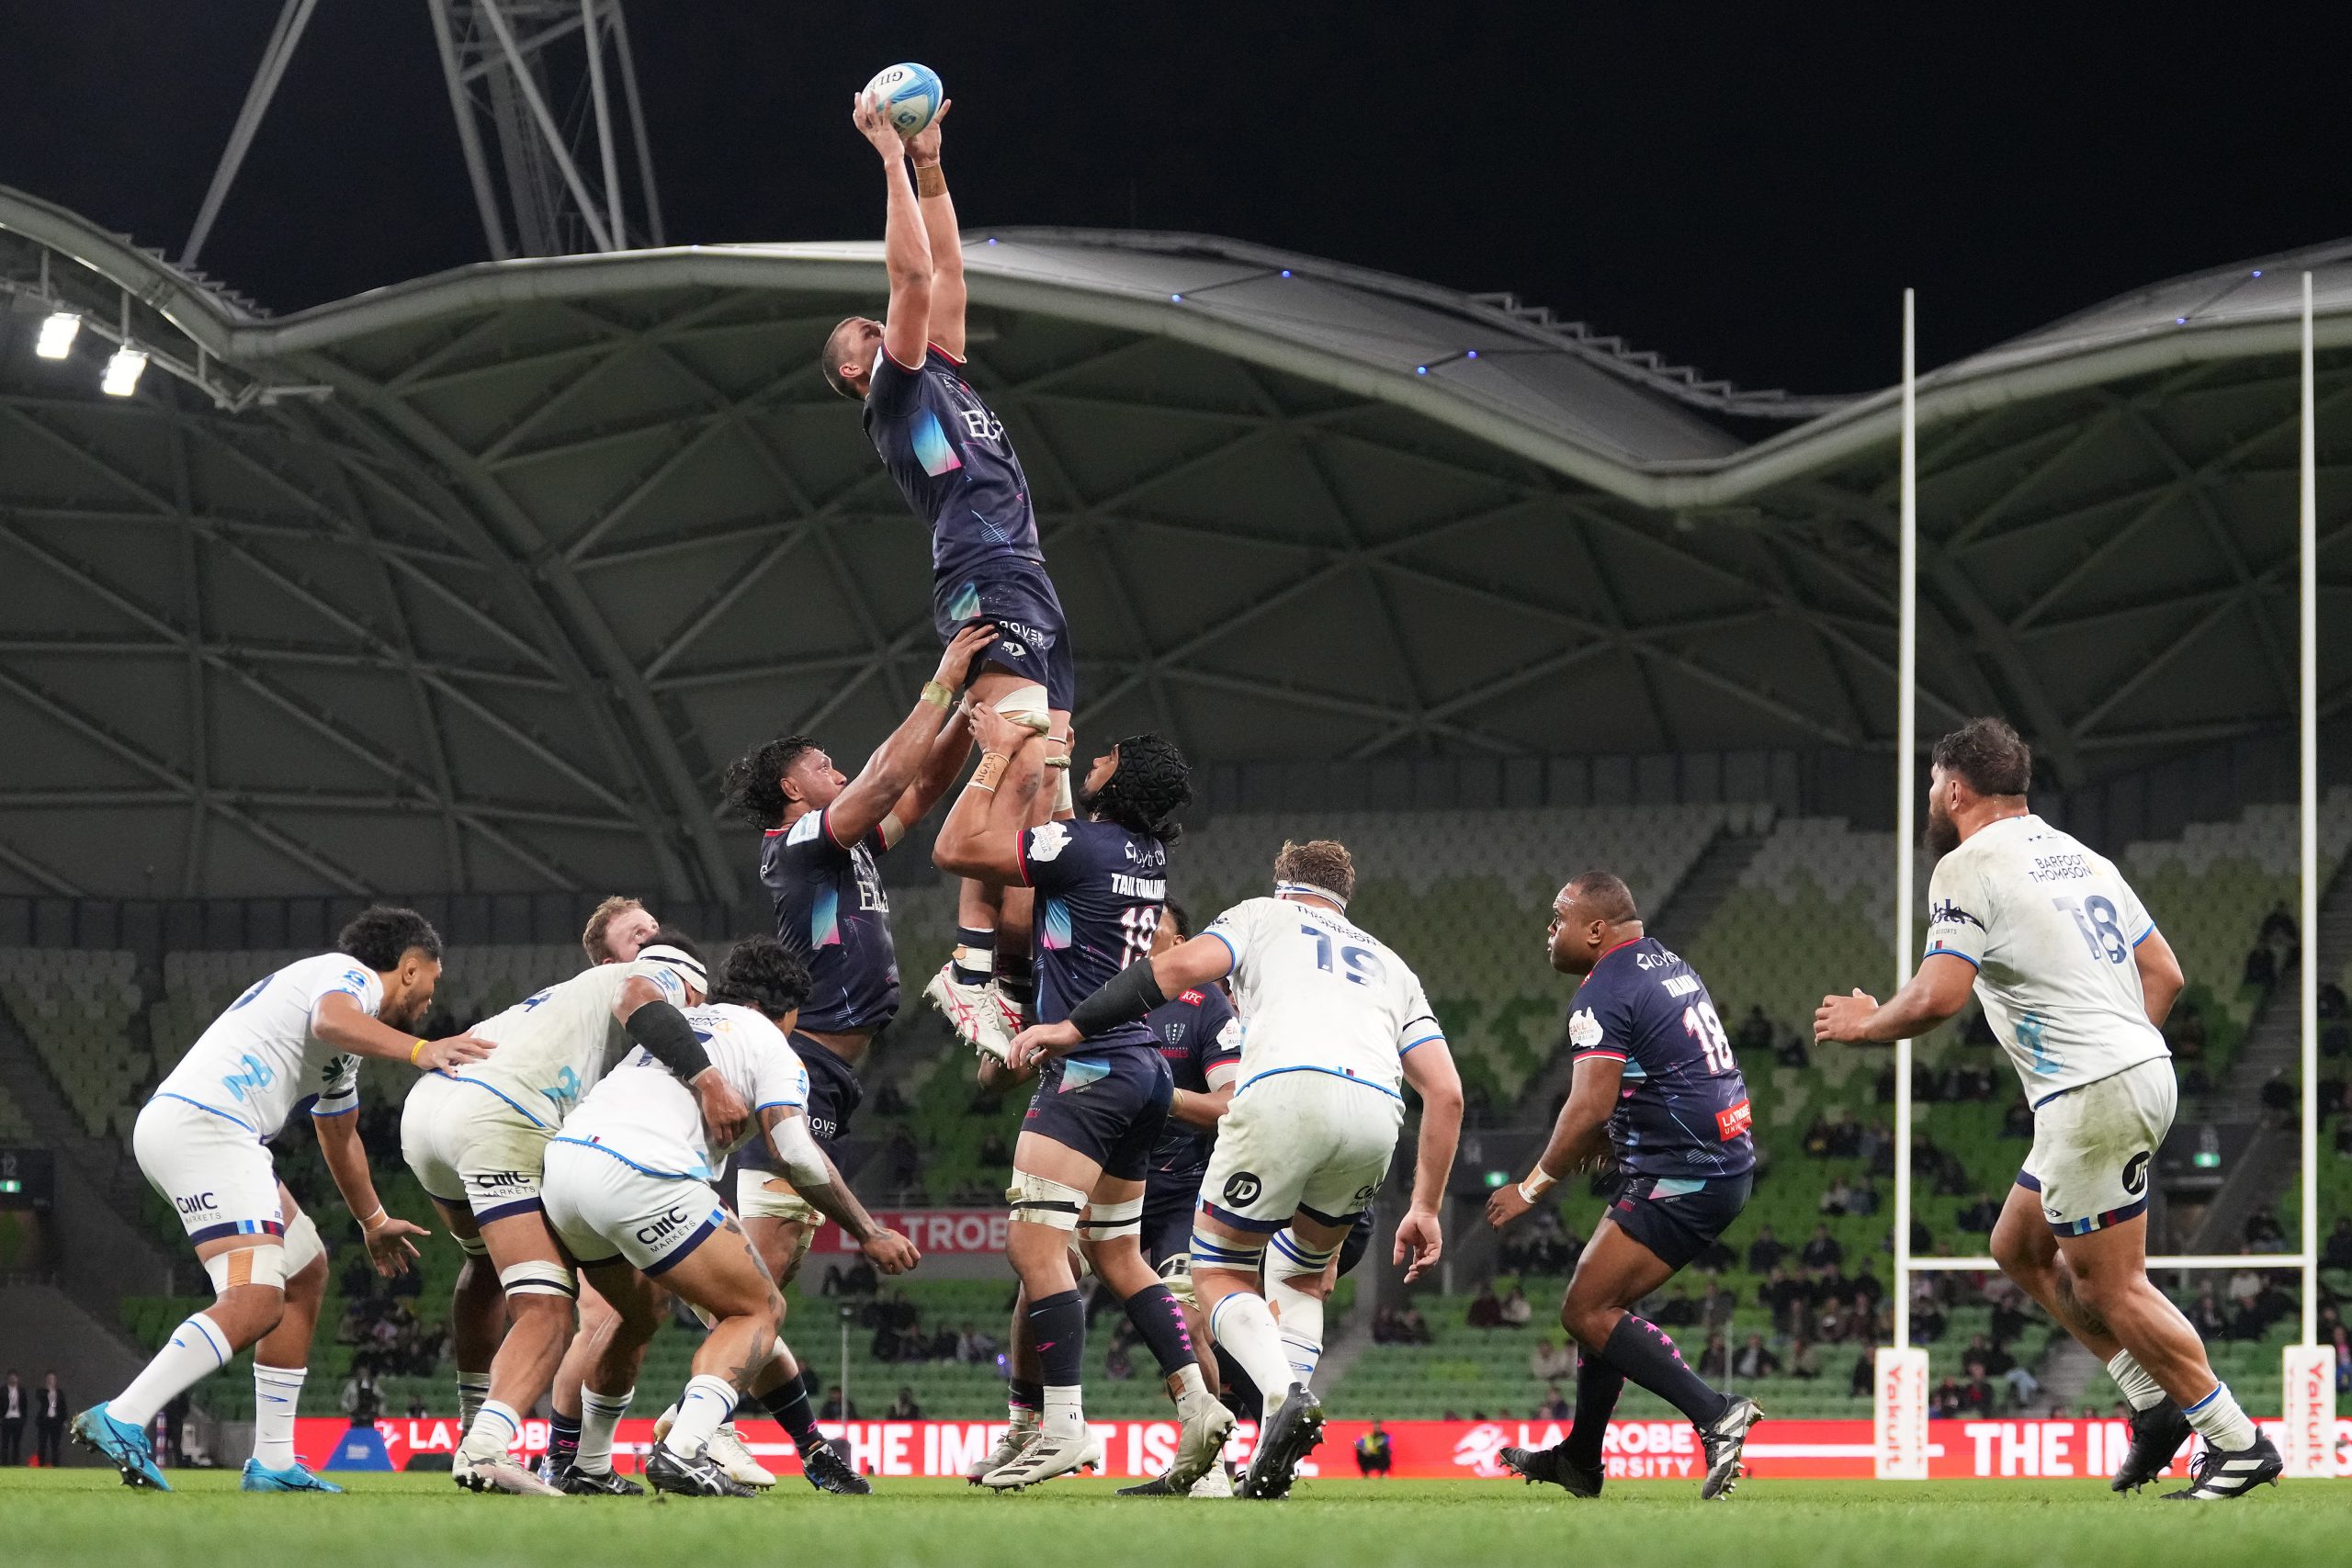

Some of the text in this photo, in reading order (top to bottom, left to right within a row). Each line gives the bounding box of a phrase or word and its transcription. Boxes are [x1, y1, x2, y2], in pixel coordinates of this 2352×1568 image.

[2029, 866, 2093, 883] THOMPSON
[2035, 854, 2086, 869] BARFOOT
[2052, 895, 2127, 964] 18
[1182, 991, 1203, 1004] KFC
[1683, 1001, 1736, 1077] 18
[1226, 1179, 1258, 1201] JD
[185, 1212, 221, 1224] MARKETS
[650, 1220, 696, 1254] MARKETS
[1886, 1364, 1903, 1470] Yakult
[2308, 1361, 2324, 1470] Yakult
[409, 1421, 452, 1450] LA
[1127, 1423, 1177, 1476] IS
[1602, 1423, 1695, 1454] ROBE
[1964, 1423, 2074, 1476] THE
